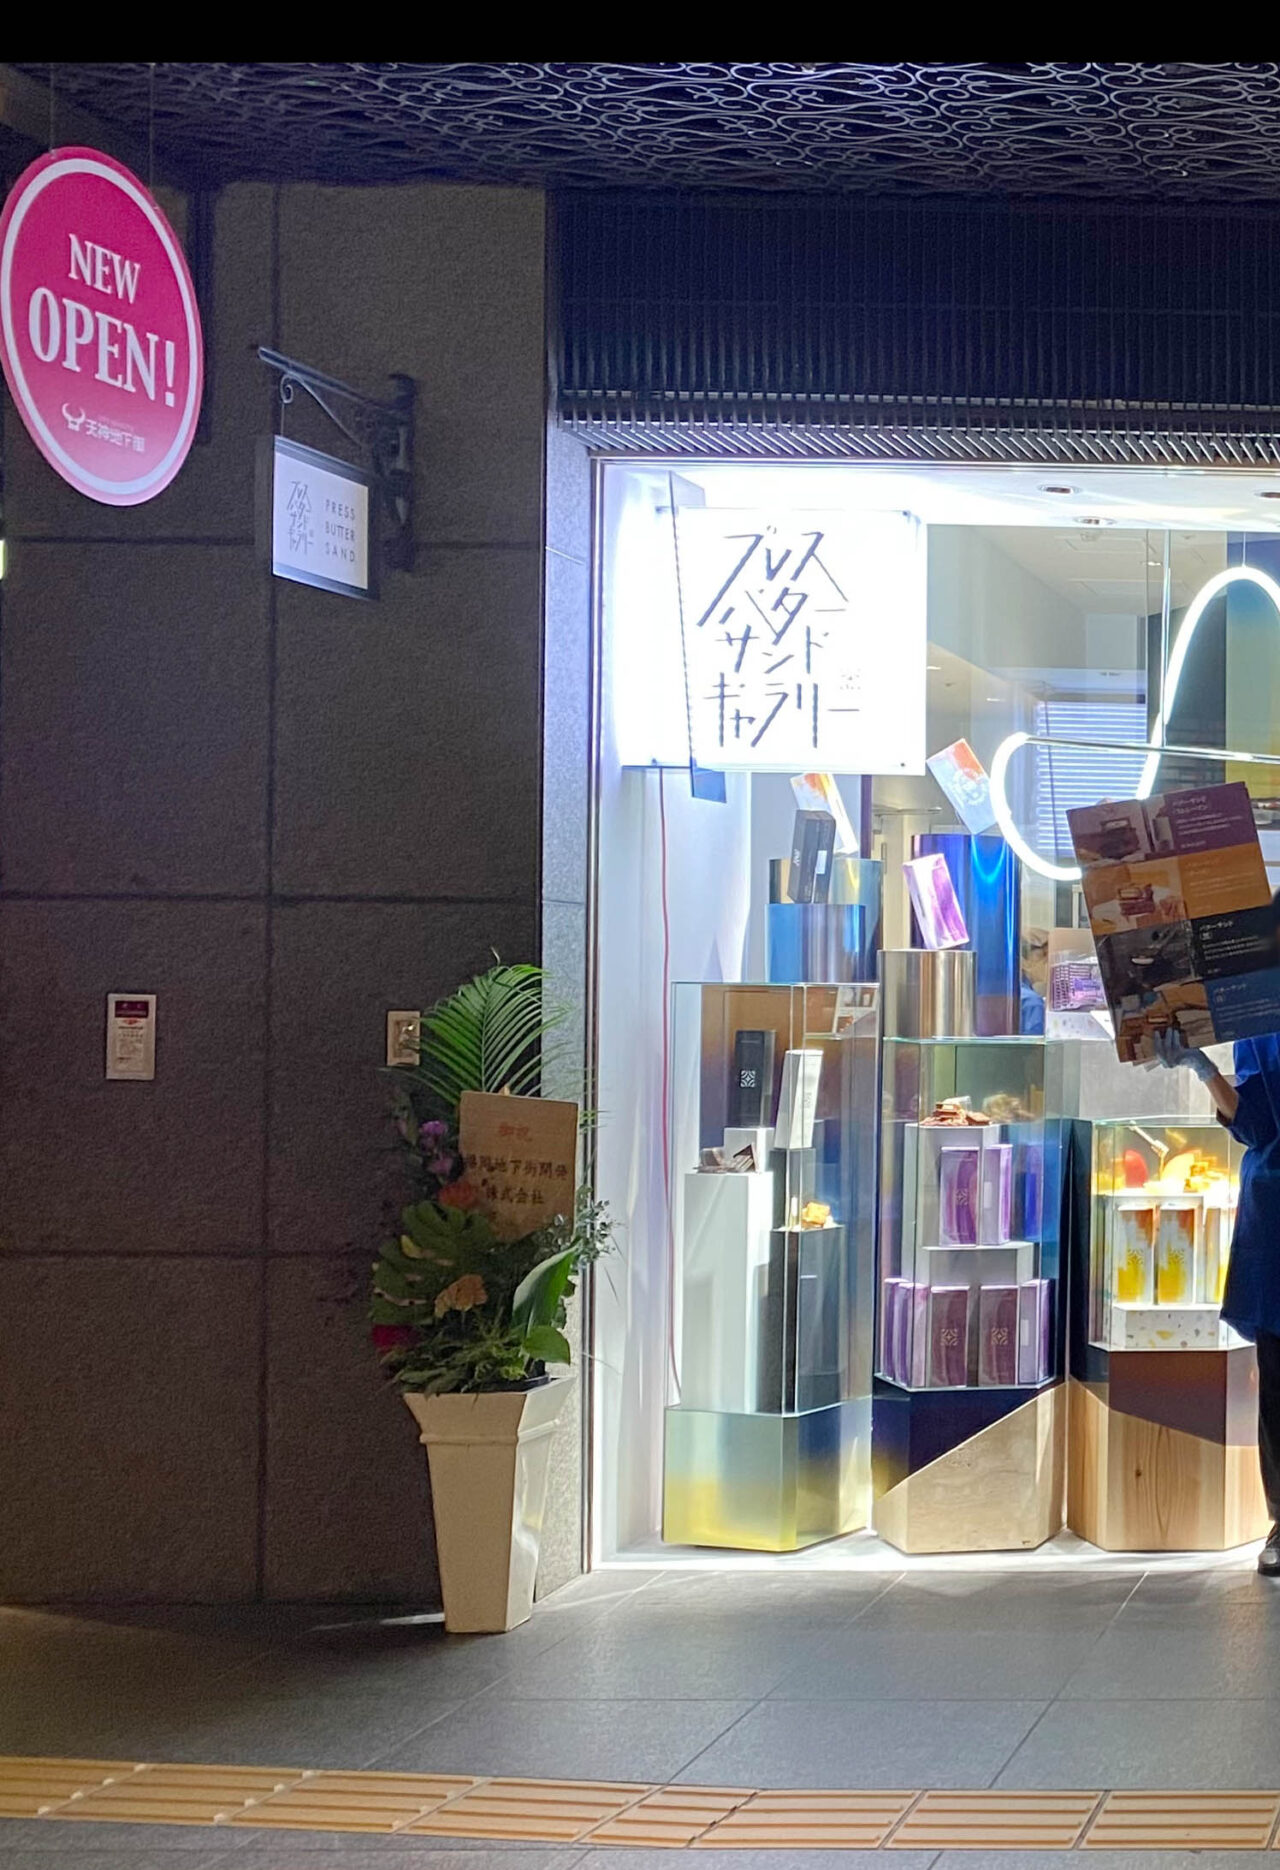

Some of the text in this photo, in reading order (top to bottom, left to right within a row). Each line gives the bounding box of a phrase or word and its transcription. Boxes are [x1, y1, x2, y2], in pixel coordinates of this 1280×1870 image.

[68, 233, 140, 304] NEW
[28, 287, 175, 407] OPEN!
[325, 499, 356, 521] PRESS
[325, 521, 356, 541] BUTTER
[325, 542, 356, 562] SAND
[696, 525, 848, 627] プレス
